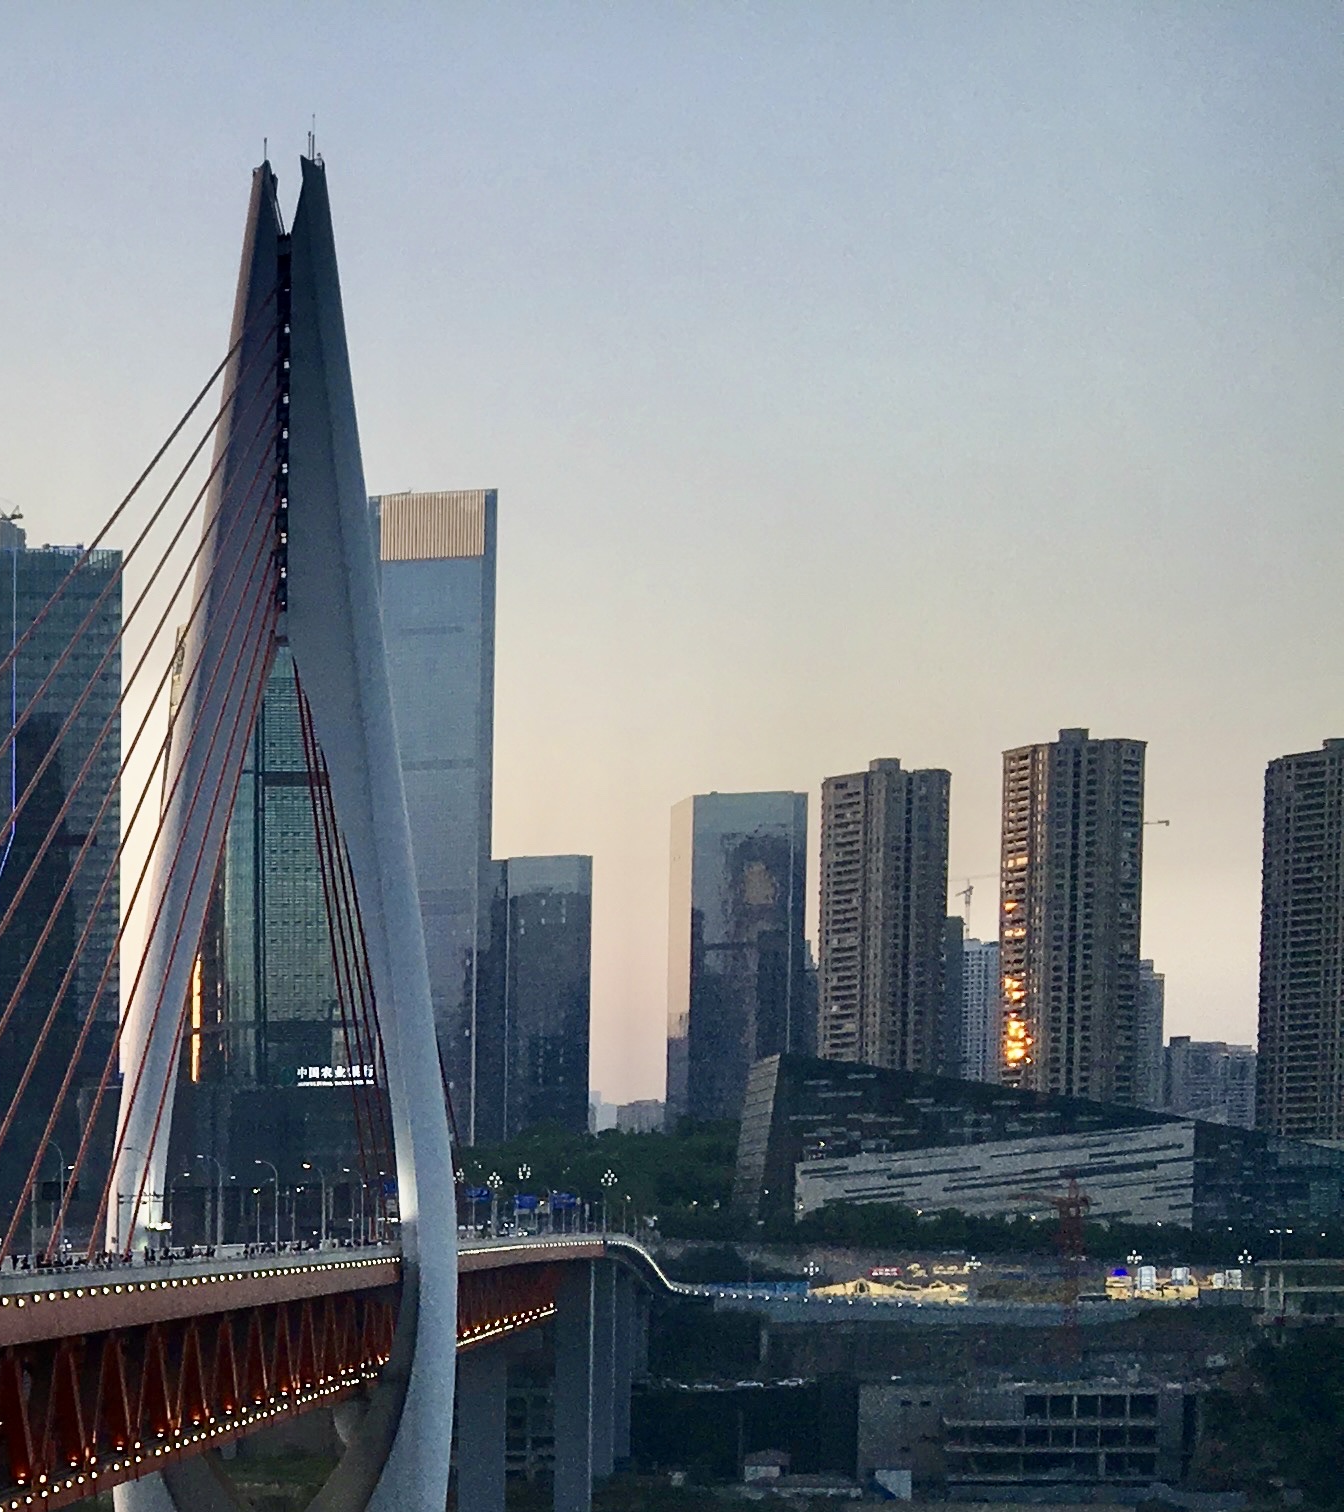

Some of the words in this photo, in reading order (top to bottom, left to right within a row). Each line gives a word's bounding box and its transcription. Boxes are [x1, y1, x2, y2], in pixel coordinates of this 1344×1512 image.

[296, 1064, 374, 1079] 中国农业银行
